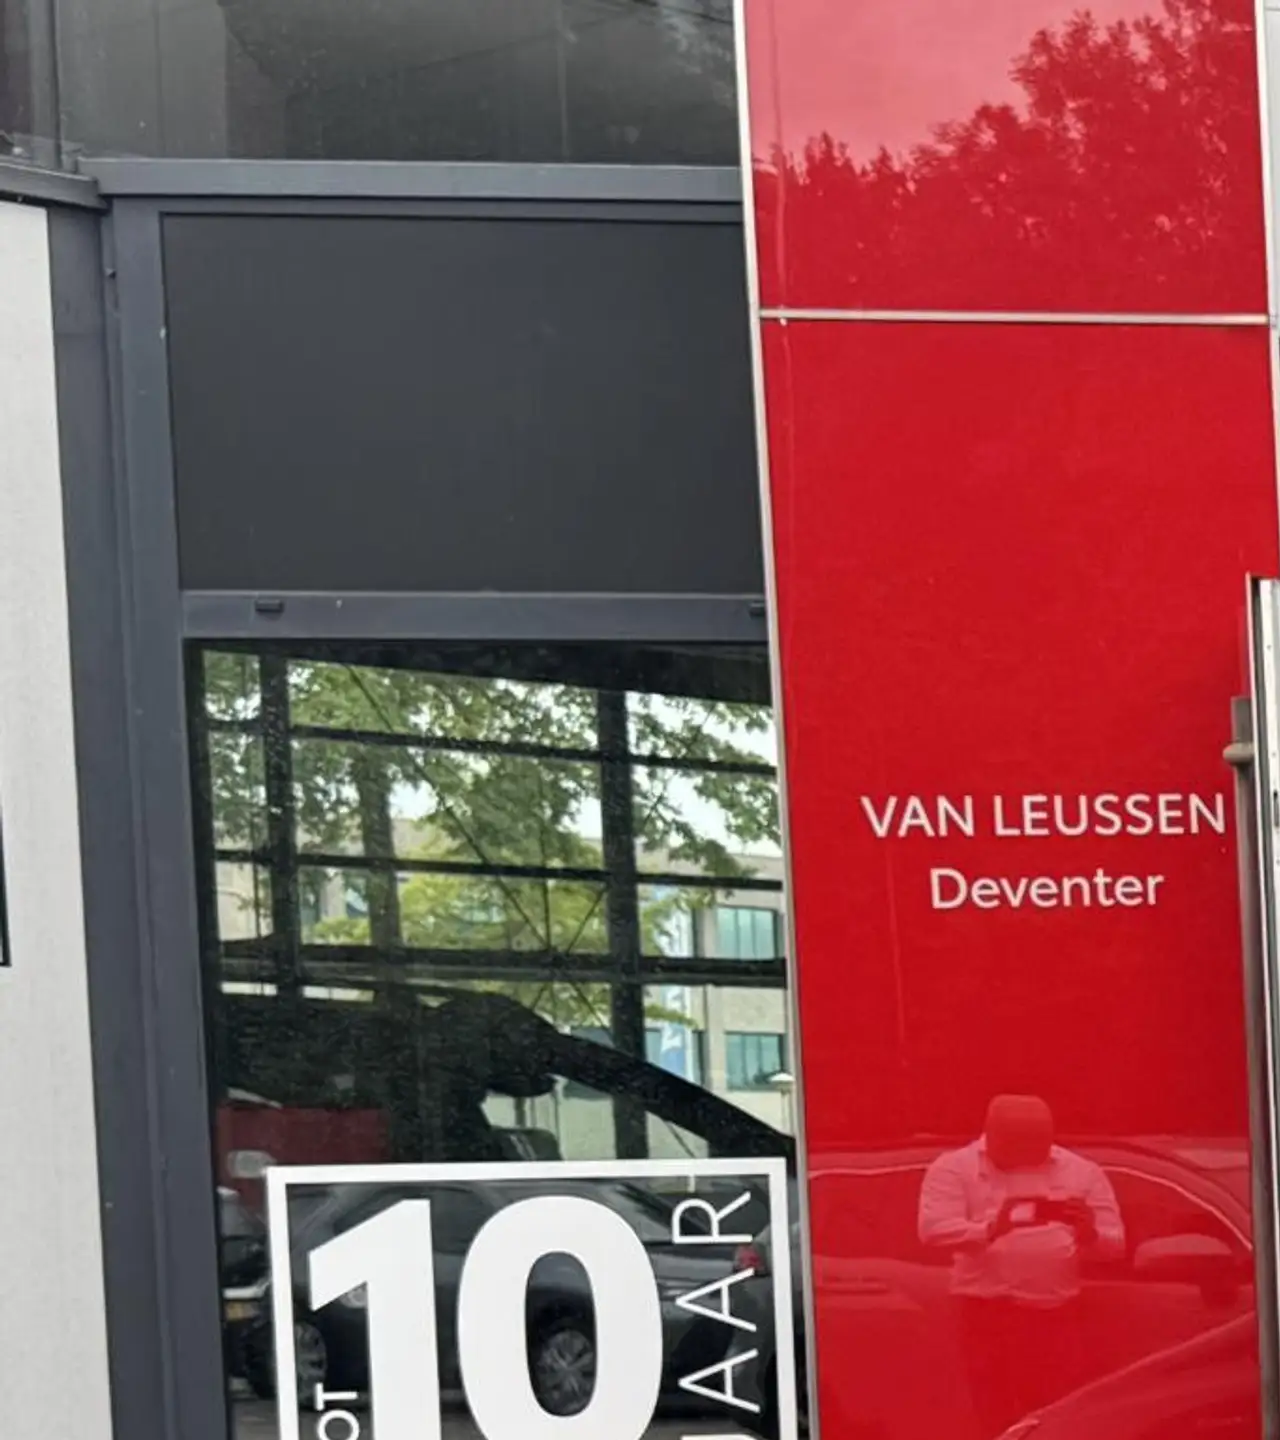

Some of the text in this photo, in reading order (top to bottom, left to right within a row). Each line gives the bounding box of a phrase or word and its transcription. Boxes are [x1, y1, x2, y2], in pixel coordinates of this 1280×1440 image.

[861, 793, 1227, 838] VAN LEUSSEN
[930, 867, 1165, 909] Deventer
